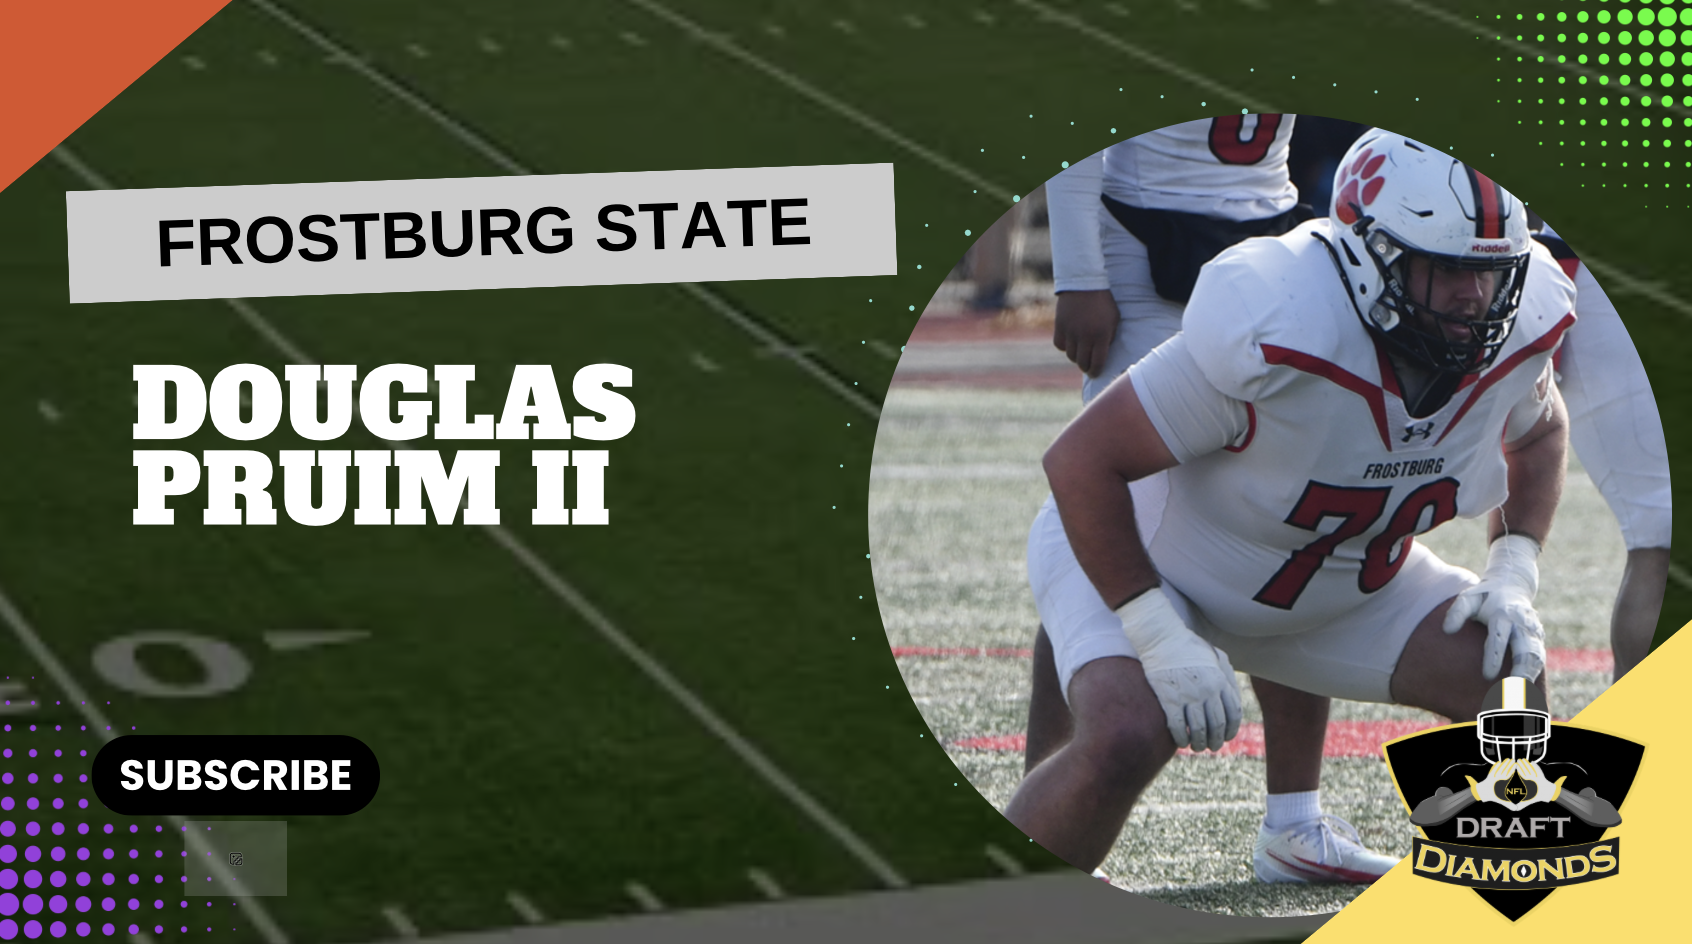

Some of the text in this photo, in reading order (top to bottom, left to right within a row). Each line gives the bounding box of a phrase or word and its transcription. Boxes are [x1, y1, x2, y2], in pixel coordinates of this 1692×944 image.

[1472, 244, 1511, 254] Riddell
[1363, 458, 1445, 480] FROSTBURG
[1251, 477, 1461, 611] 70
